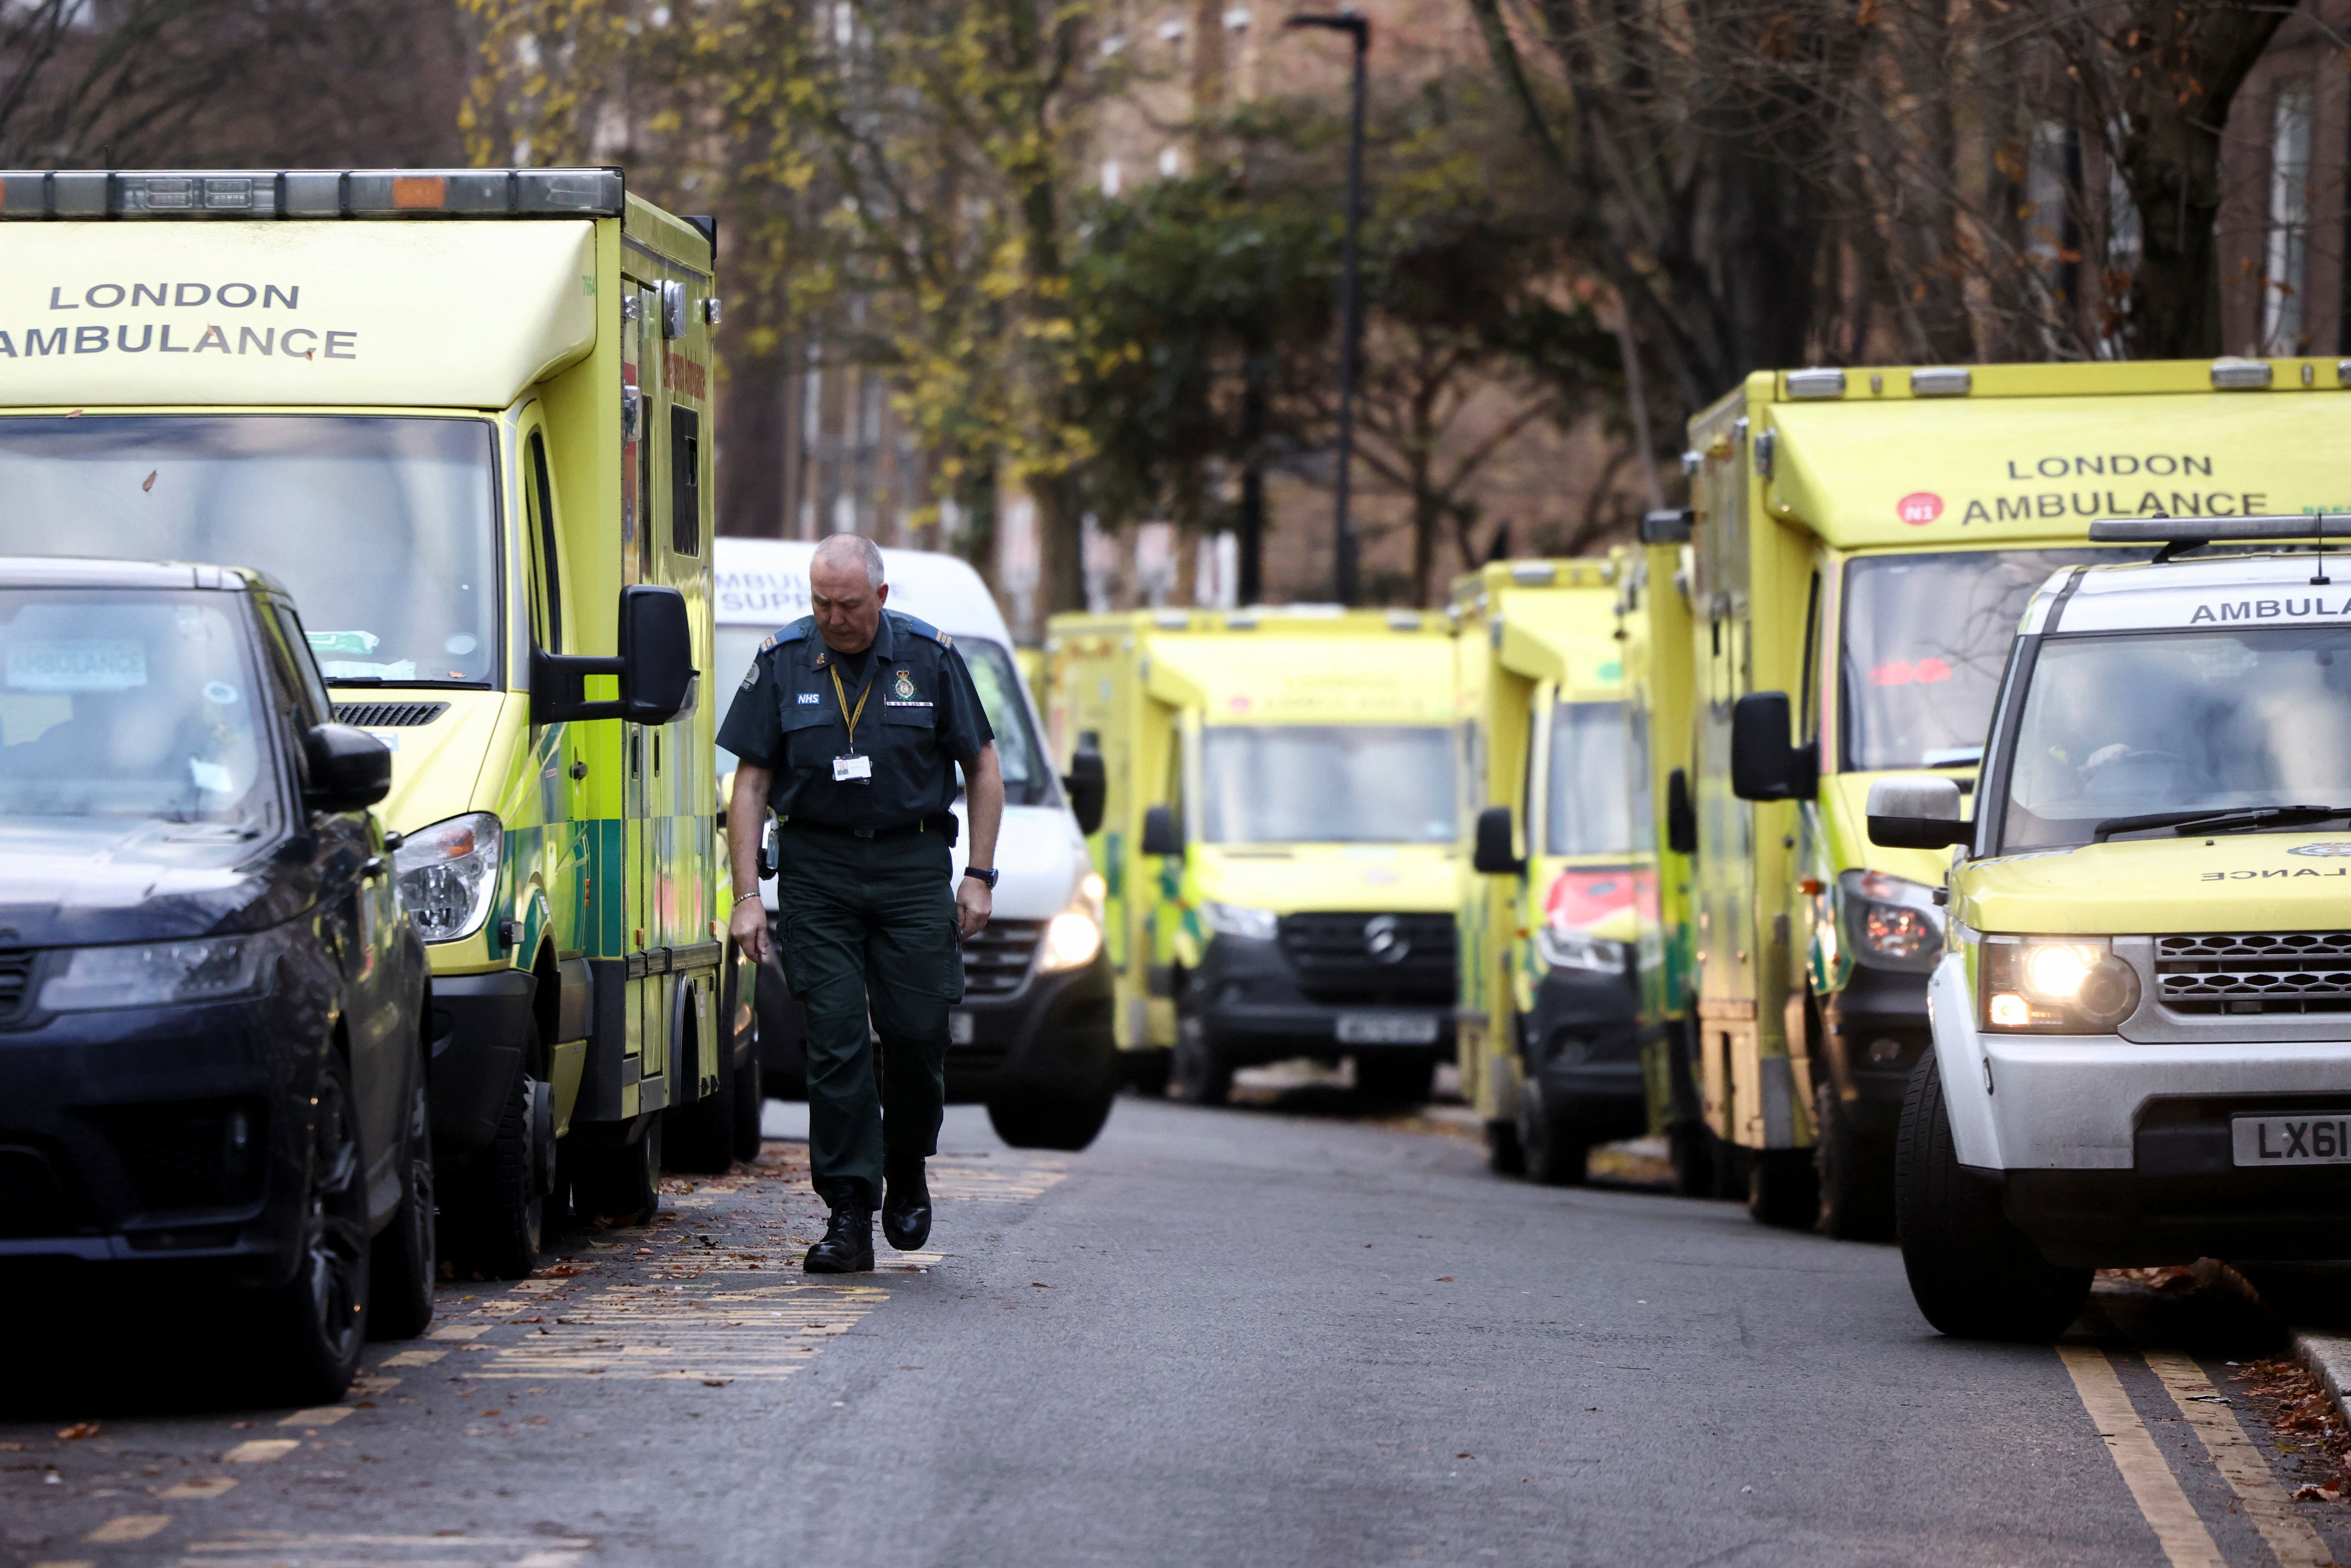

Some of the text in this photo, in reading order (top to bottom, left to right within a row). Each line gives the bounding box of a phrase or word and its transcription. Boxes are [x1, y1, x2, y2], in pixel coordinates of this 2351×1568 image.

[49, 282, 299, 310] LONDON
[0, 325, 357, 360] AMBULANCE
[2007, 455, 2213, 480] LONDON
[1962, 491, 2267, 526] AMBULANCE
[721, 592, 811, 611] SUPP
[798, 694, 819, 704] NHS
[2259, 1121, 2348, 1158] LX61
